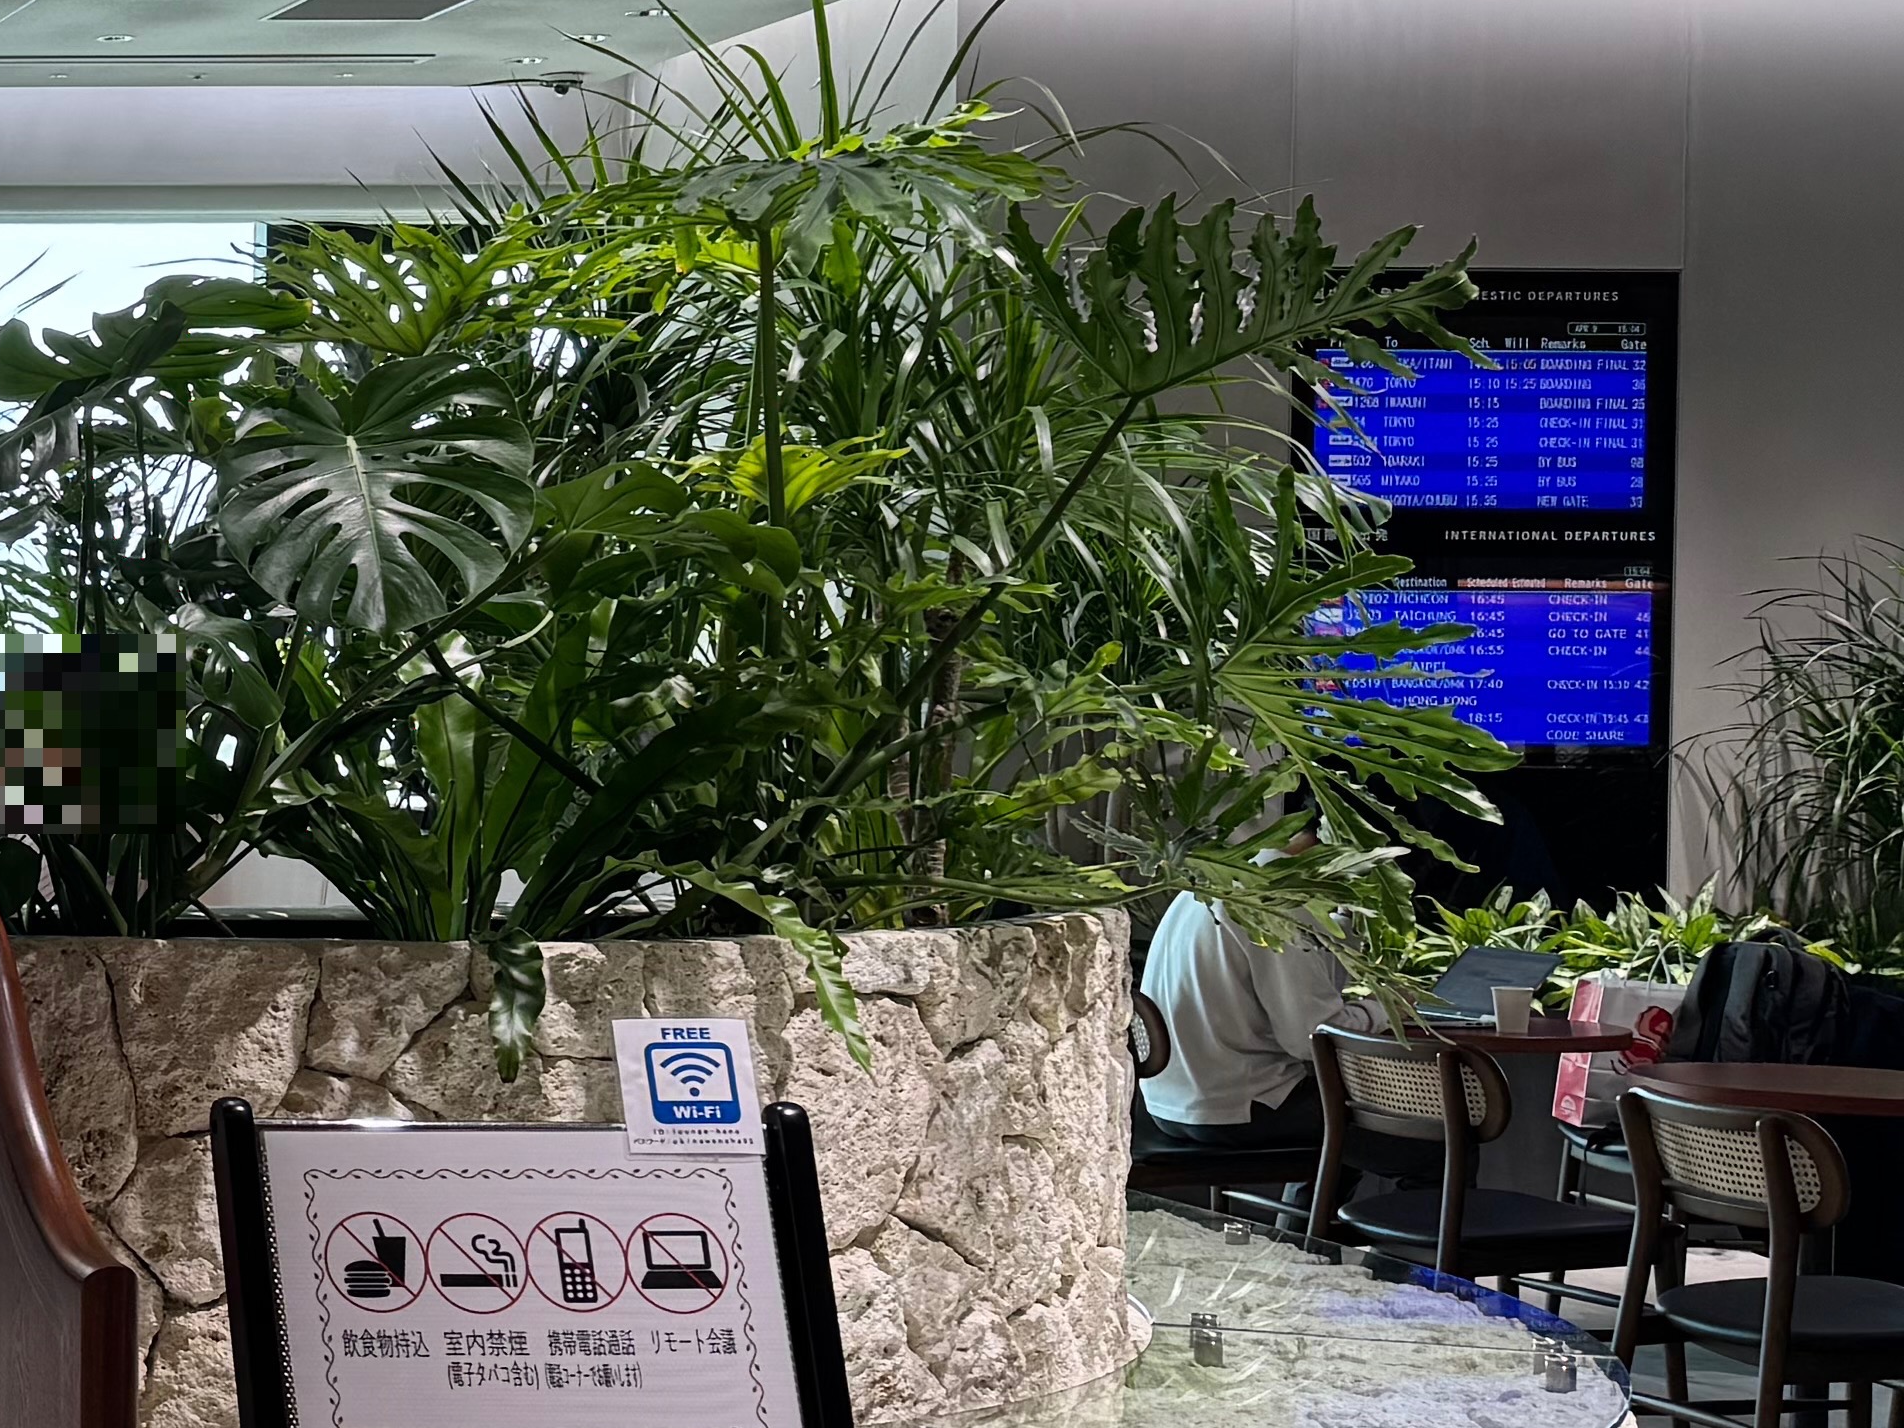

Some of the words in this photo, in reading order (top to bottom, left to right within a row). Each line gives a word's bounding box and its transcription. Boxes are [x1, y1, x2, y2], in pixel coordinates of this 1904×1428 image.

[1474, 290, 1522, 301] ESTIC
[1528, 290, 1619, 301] DEPARTURES
[1384, 336, 1399, 348] To
[1504, 337, 1529, 350] Will
[1540, 337, 1587, 350] Remarks
[1620, 338, 1648, 351] Gate
[1540, 358, 1592, 371] BOARDING
[1596, 359, 1629, 371] FINAL
[1469, 377, 1500, 390] 15:10
[1539, 378, 1592, 390] BOARDING
[1468, 397, 1500, 409] 15:15
[1539, 397, 1591, 410] BOARDING
[1596, 397, 1628, 410] FINAL
[1595, 417, 1628, 430] FINAL
[1595, 437, 1628, 449] FINAL
[1445, 530, 1558, 541] INTERNATIONAL
[1564, 531, 1656, 542] DEPARTURES
[1564, 578, 1608, 589] Remarks
[1625, 578, 1655, 589] Gate
[1471, 628, 1505, 639] 6:45
[1548, 628, 1566, 640] GO
[1572, 628, 1589, 640] TO
[1594, 628, 1628, 640] GATE
[1546, 730, 1580, 741] CODE
[1585, 730, 1625, 741] SHARE
[660, 1027, 711, 1040] FREE
[673, 1105, 722, 1119] Wi-Fi
[342, 1328, 431, 1358] 飲食物持込
[443, 1329, 531, 1357] 室内禁煙
[547, 1328, 636, 1356] 携帯電話通話
[650, 1328, 738, 1355] リモート会議
[447, 1360, 540, 1391] (電子タバコ含む)
